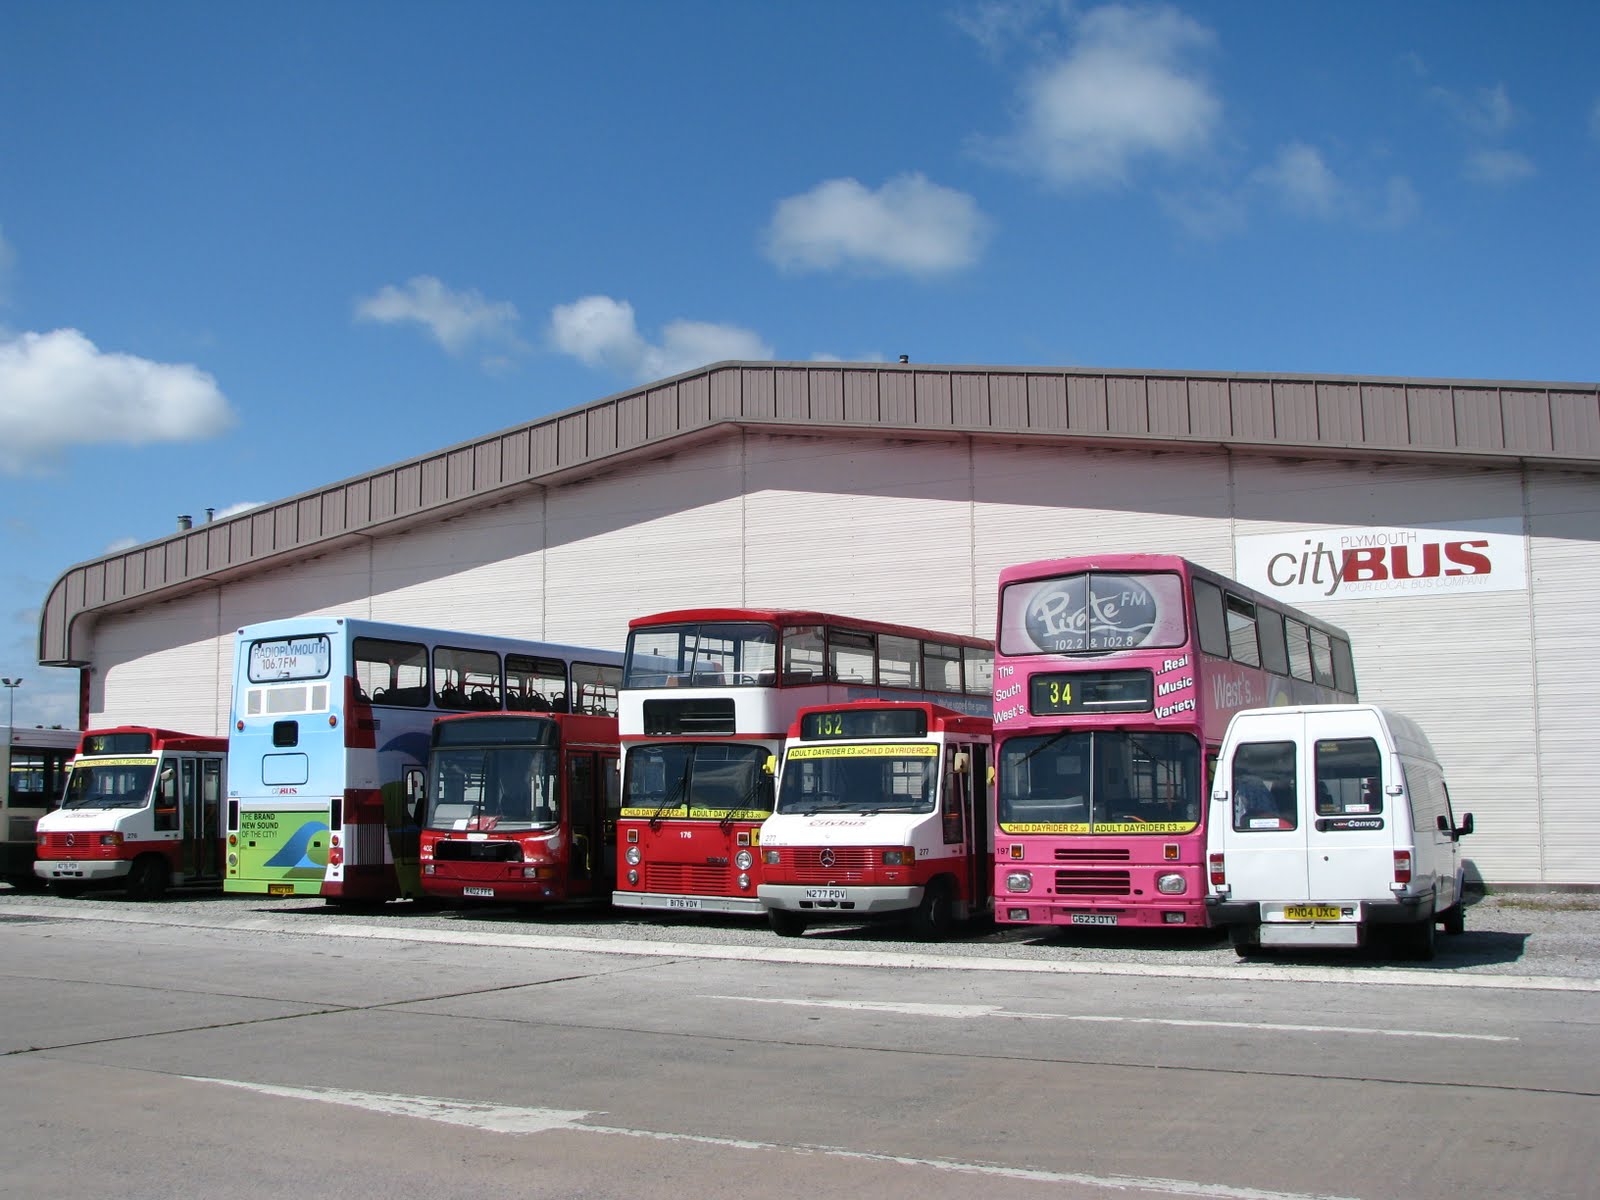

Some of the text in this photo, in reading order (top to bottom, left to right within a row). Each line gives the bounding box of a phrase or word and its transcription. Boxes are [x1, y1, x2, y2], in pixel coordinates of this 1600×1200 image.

[1341, 532, 1417, 548] PLYMOUTH
[1342, 575, 1489, 592] YOUR LOCAL BUS COMPANY
[1033, 590, 1146, 637] Pirate FM
[1055, 635, 1133, 650] 102.2 & 102.8
[997, 665, 1014, 679] The
[1158, 676, 1193, 696] Music
[995, 683, 1021, 702] South
[1050, 682, 1071, 705] 34
[1154, 698, 1196, 719] Variety
[816, 714, 842, 735] 152
[790, 749, 812, 757] ADULT
[812, 748, 846, 756] DAYRIDER
[862, 747, 884, 755] CHILD
[885, 746, 922, 754] DAYRIDER
[624, 808, 641, 816] CHILD
[714, 810, 745, 818] DAYDER
[1008, 824, 1030, 832] CHILD
[1032, 824, 1069, 832] DAYRIDER
[1095, 824, 1122, 832] ADULT
[1124, 824, 1165, 832] DAYRIDER
[1348, 819, 1381, 828] Convoy
[465, 887, 480, 895] R402
[806, 889, 845, 899] N277 PDV
[670, 899, 698, 908] B176 VDV
[1288, 908, 1336, 917] PN04 UXC
[1072, 915, 1116, 924] G623 OTV
